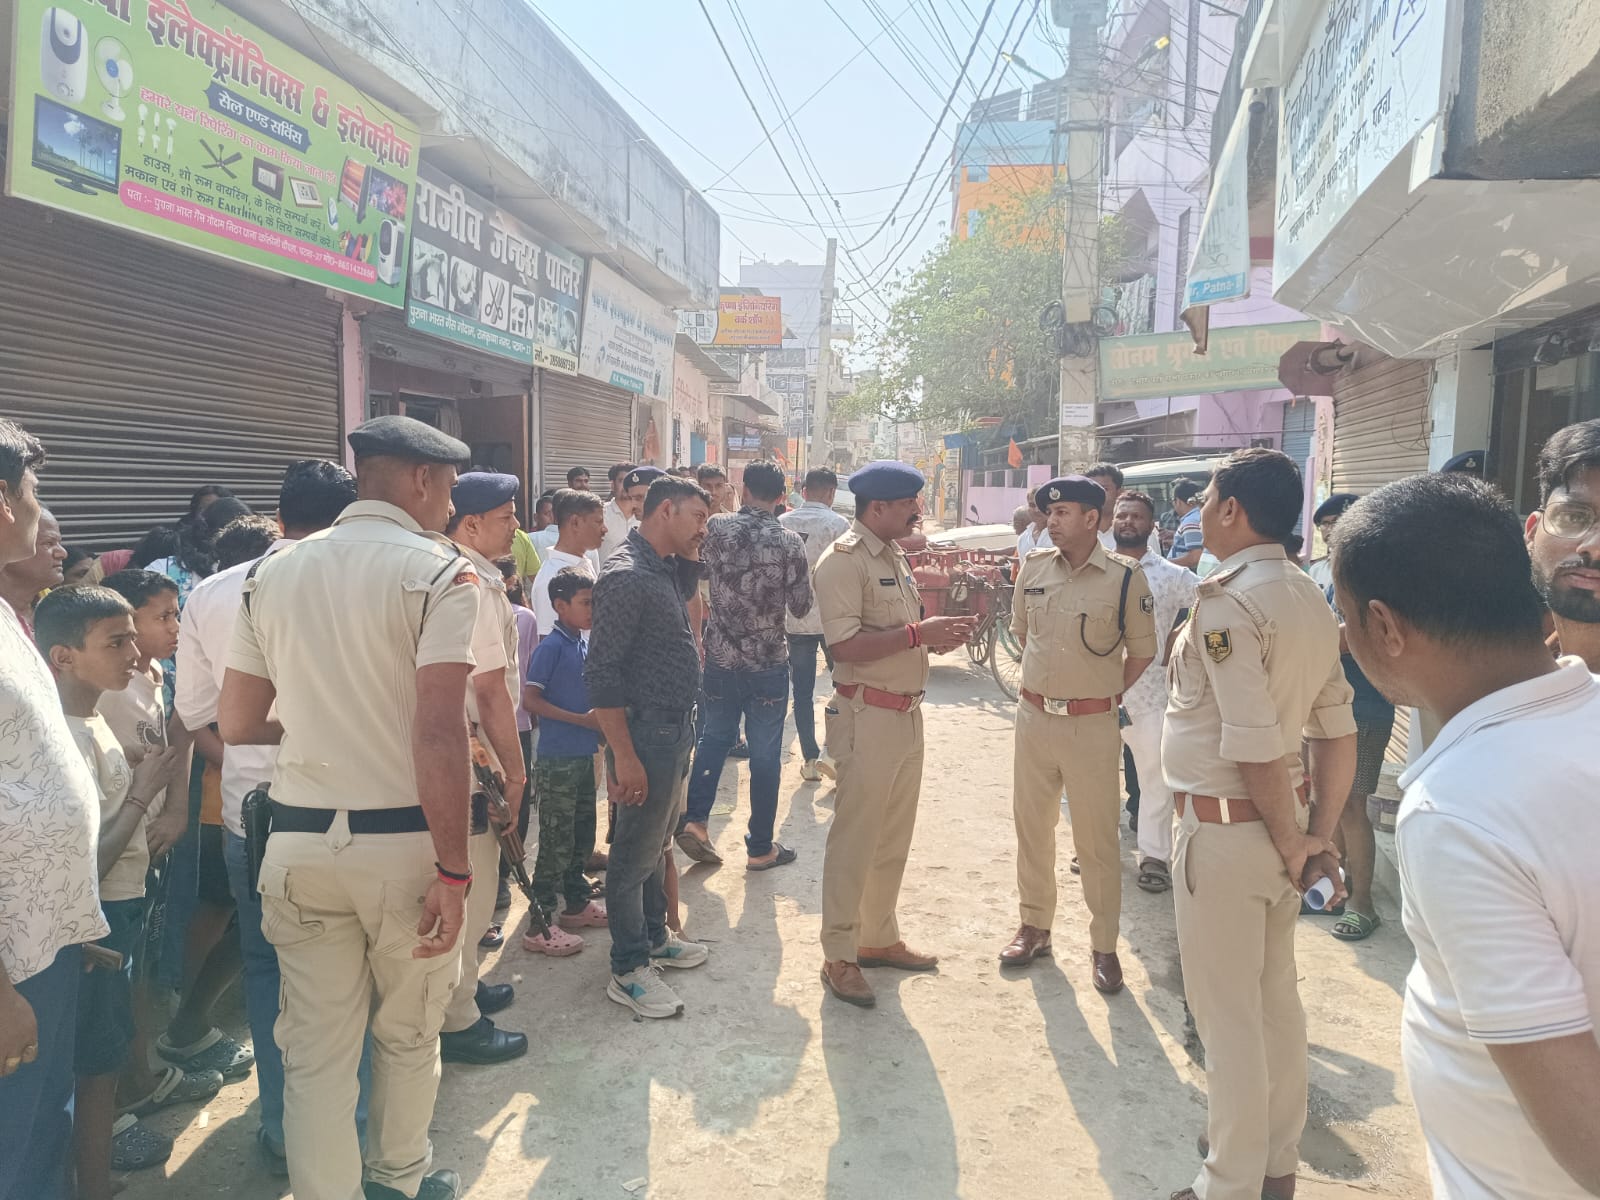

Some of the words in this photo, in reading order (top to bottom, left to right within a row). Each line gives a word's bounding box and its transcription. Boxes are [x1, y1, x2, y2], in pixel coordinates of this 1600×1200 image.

[219, 91, 244, 115] सेल
[246, 107, 269, 129] एण्ड
[270, 121, 303, 145] सर्विस
[312, 86, 330, 128] &
[124, 165, 159, 186] मकान
[416, 180, 483, 252] राजीव
